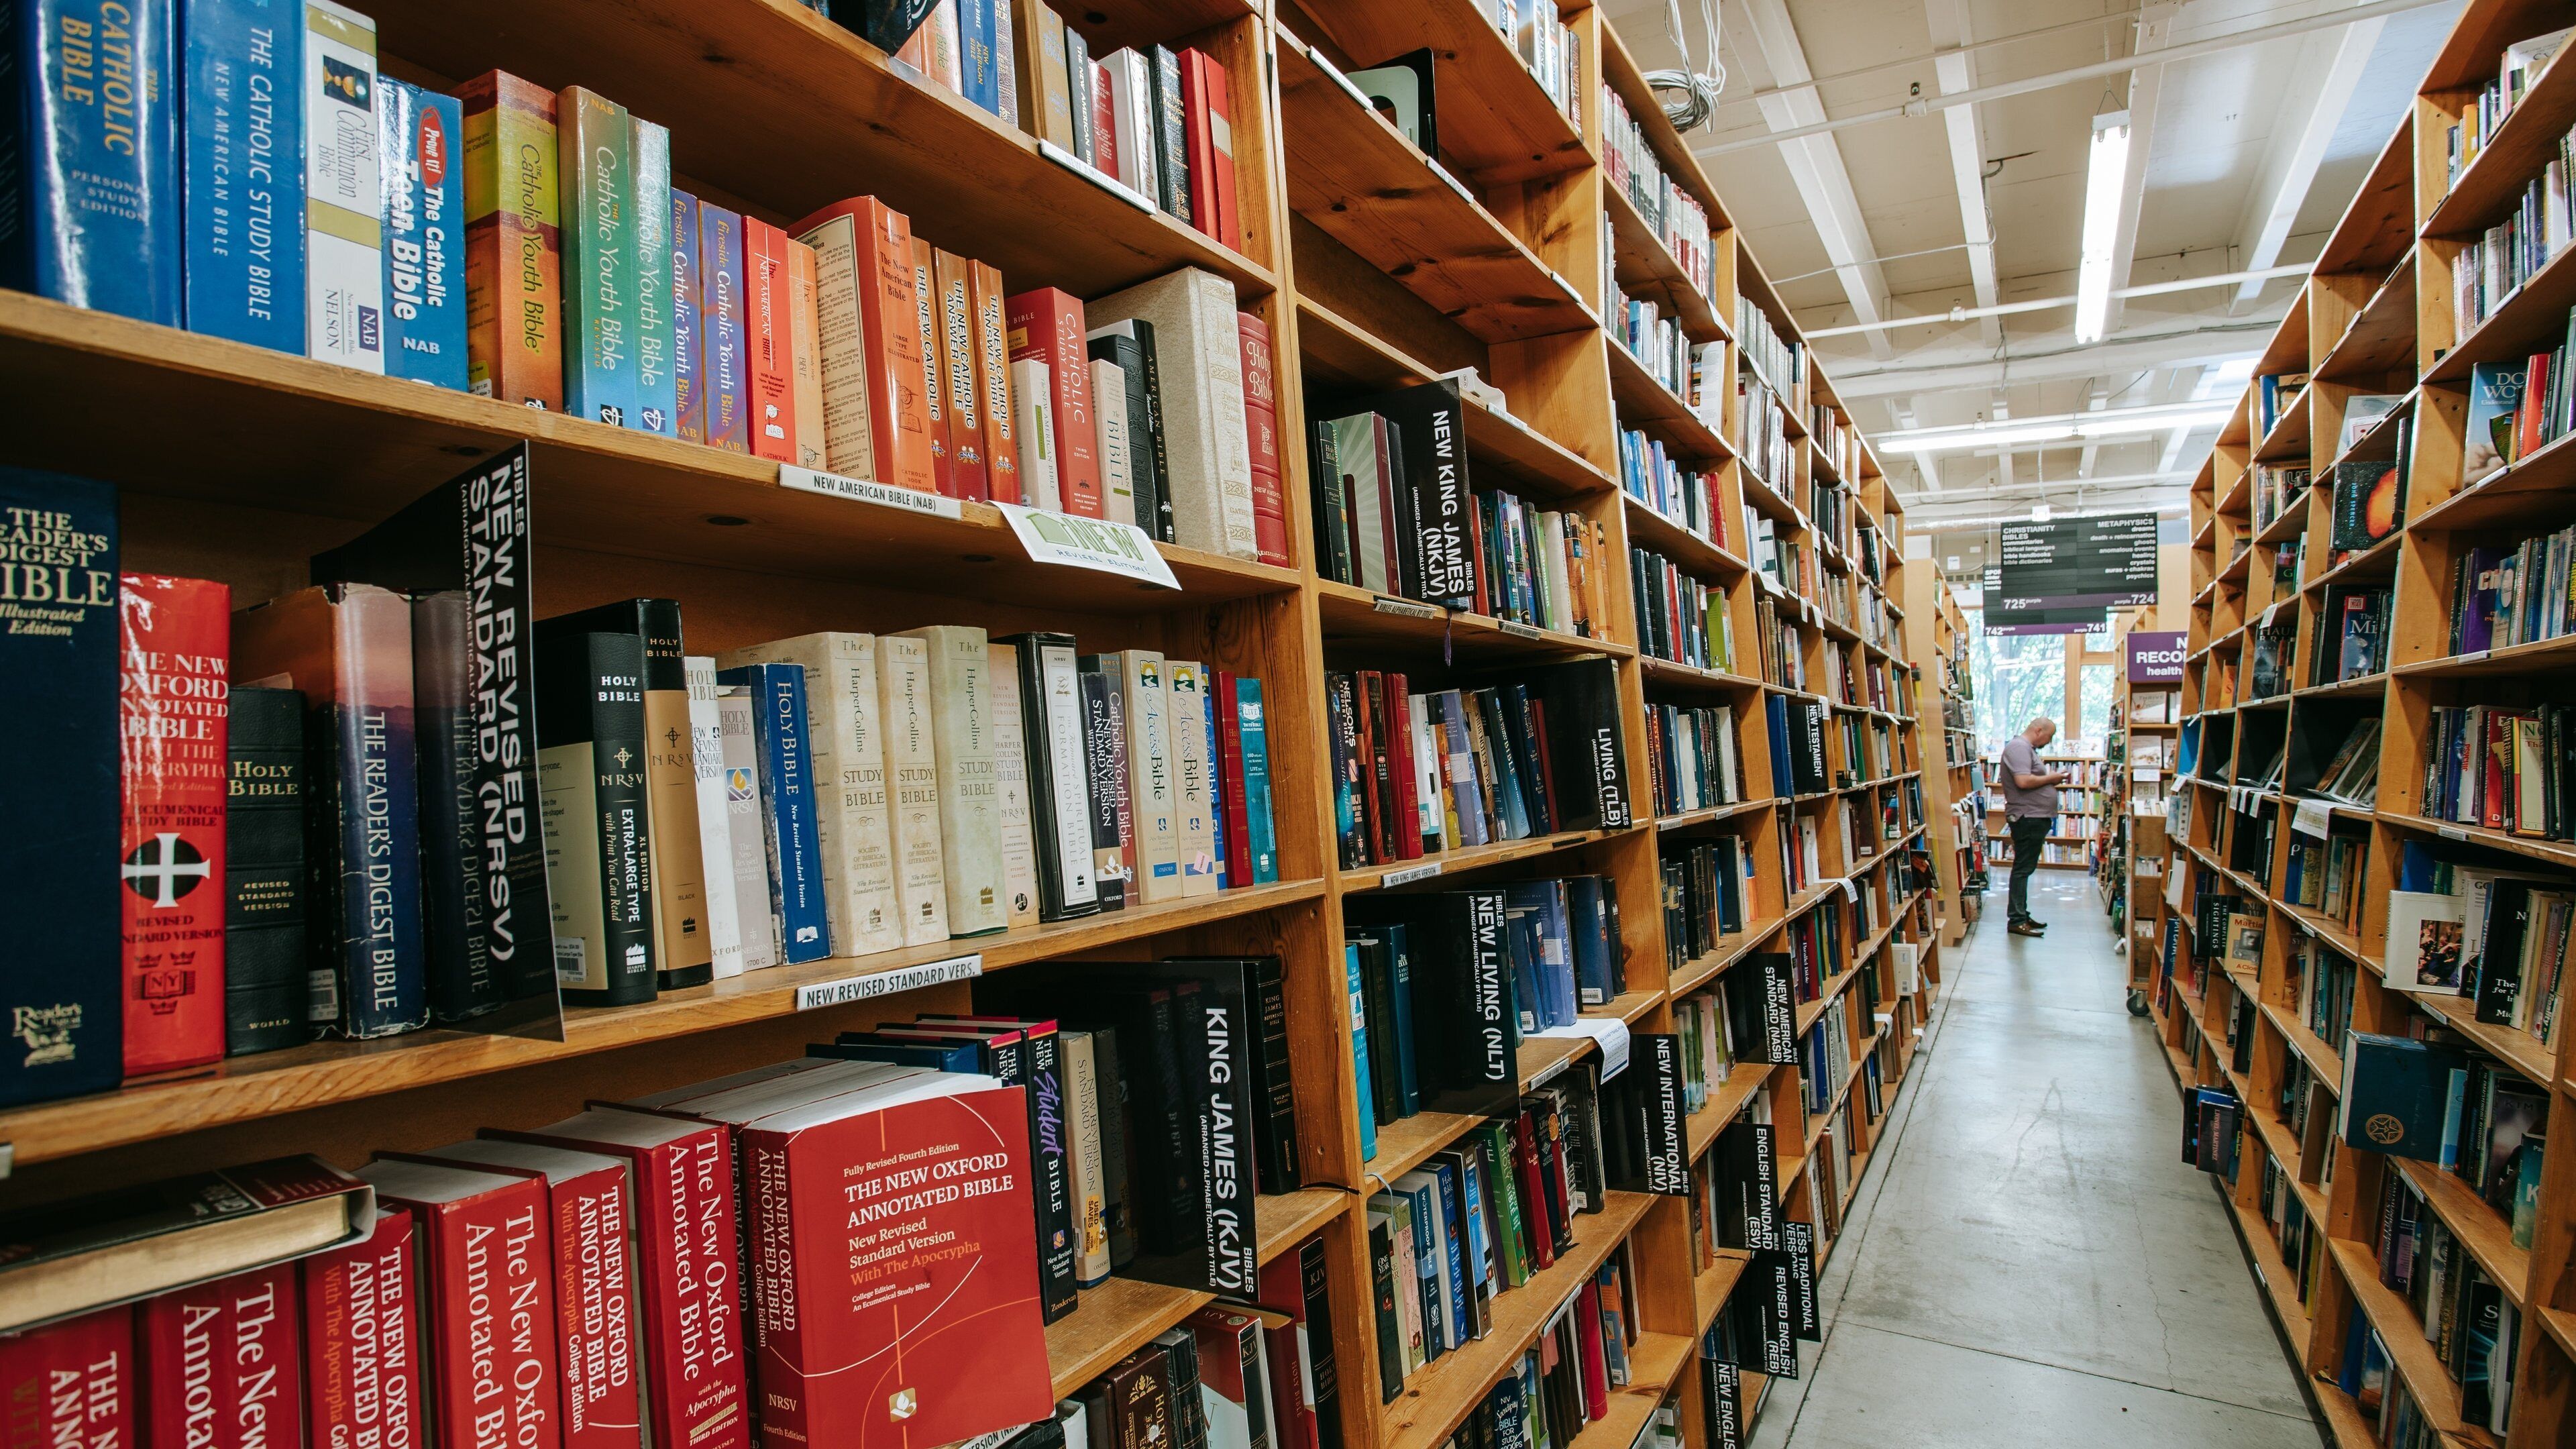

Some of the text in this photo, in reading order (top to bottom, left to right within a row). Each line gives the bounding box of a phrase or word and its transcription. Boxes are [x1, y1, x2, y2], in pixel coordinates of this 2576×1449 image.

[249, 28, 272, 321] THE CATHOLIC STUDY BIBLE
[390, 160, 422, 320] Teen Bible
[425, 187, 447, 307] The Catholic
[326, 288, 339, 350] NELSON
[403, 337, 440, 354] NAB
[514, 455, 523, 537] BIBLES
[814, 476, 936, 512] NEW AMERICAN BIBLE (NAB)
[1433, 411, 1464, 593] NEW KING JAMES
[2003, 525, 2055, 534] CHRISTIANITY
[2098, 519, 2154, 527] METAPHYSICS
[1415, 521, 1425, 571] ALPHABETICALLY
[1420, 572, 1426, 580] BY
[1422, 527, 1446, 596] (NKJV)
[1465, 561, 1474, 591] BIBLES
[2131, 594, 2155, 604] 724
[1379, 604, 1391, 612] BIBLES
[1392, 605, 1416, 616] ALPHABETICAL
[1422, 610, 1432, 619] TITLE
[2004, 599, 2026, 609] 725
[843, 641, 863, 651] The
[1986, 627, 2003, 635] 742
[2087, 623, 2105, 633] 741
[491, 464, 526, 845] NEW REVISED
[2147, 667, 2182, 676] health
[598, 691, 640, 702] BIBLE
[602, 676, 637, 686] HOLY
[470, 475, 515, 960] STANDARD (NRSV)
[850, 667, 865, 753] HarperCollins
[1809, 705, 1823, 777] NEW TESTAMENT
[602, 774, 643, 786] NRSV
[843, 769, 882, 784] STUDY
[846, 792, 884, 806] BIBLE
[1598, 728, 1621, 826] LIVING (TLB)
[364, 712, 398, 1012] THE READER'S DIGEST BIBLE
[1391, 867, 1436, 885] NEW KING JAMES VERSION
[1468, 896, 1477, 931] (ARRANGED
[1495, 896, 1504, 927] BIBLES
[1472, 932, 1480, 983] ALPHABETICALLY
[806, 963, 975, 1007] NEW REVISED STANDARD VERS.
[1477, 897, 1505, 1080] NEW LIVING (NLT)
[1765, 967, 1778, 1024] STANDARD
[1777, 979, 1793, 1063] NEW AMERICAN
[1769, 1026, 1782, 1063] (NASB)
[1656, 1038, 1681, 1194] NEW INTERNATIONAL
[843, 1142, 959, 1177] Fully Revised Fourth Edition
[1206, 1008, 1242, 1289] KING JAMES (KJV)
[845, 1151, 1009, 1203] THE NEW OXFORD
[1650, 1156, 1667, 1191] (NIV)
[1757, 1128, 1773, 1249] ENGLISH STANDARD
[847, 1174, 1014, 1229] ANNOTATED BIBLE
[1199, 1115, 1216, 1287] (ARRANGED ALPHABETICALLY BY TITLE)
[696, 1132, 735, 1368] The New Oxford
[848, 1218, 927, 1252] New Revised
[849, 1229, 955, 1269] Standard Version
[1748, 1217, 1761, 1248] (ESV)
[668, 1144, 704, 1383] Annotated Bible
[850, 1240, 980, 1286] With The Apocrypha
[1244, 1246, 1254, 1293] BIBLES
[1796, 1225, 1813, 1331] LESS TRADITIONAL
[1776, 1267, 1791, 1375] REVISED ENGLISH
[1767, 1340, 1780, 1373] (REB)
[1718, 1363, 1731, 1397] NEW
